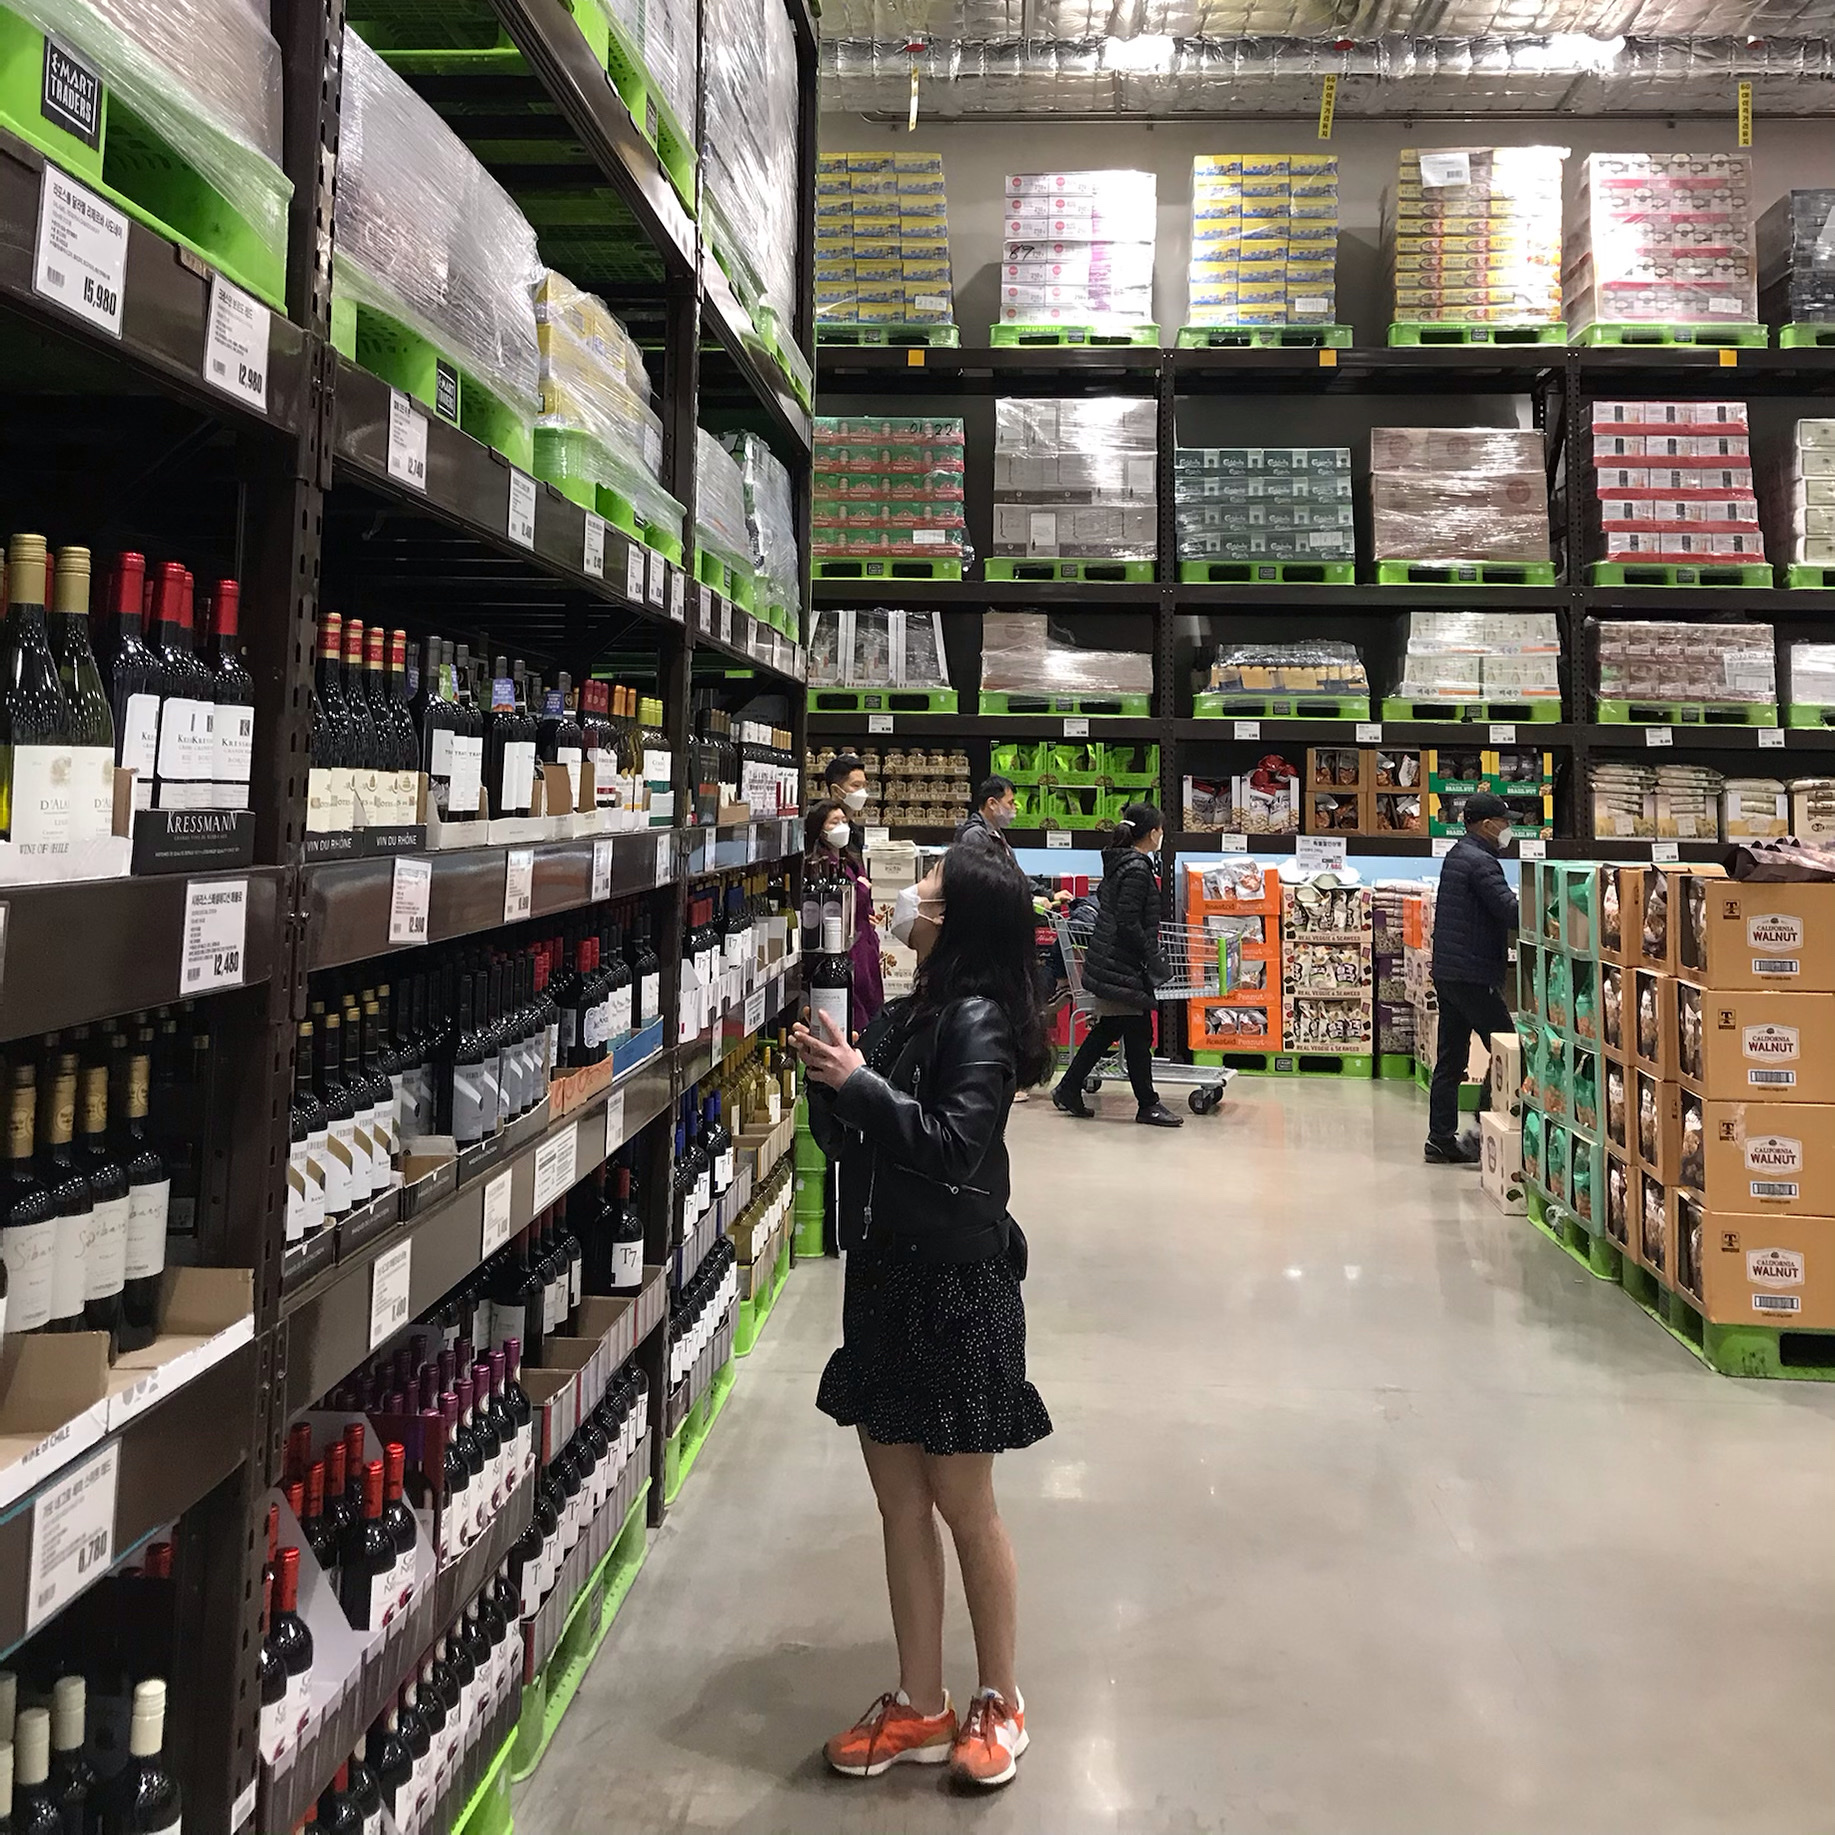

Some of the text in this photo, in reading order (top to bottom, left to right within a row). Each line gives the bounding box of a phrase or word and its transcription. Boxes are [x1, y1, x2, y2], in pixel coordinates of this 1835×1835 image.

[50, 74, 92, 122] TRADERS
[84, 276, 117, 316] 15,980
[238, 362, 263, 394] 12,980
[166, 811, 238, 834] KRESSMANN
[306, 841, 319, 852] VIN
[320, 840, 330, 850] DU
[376, 836, 387, 846] VIN
[388, 836, 396, 846] DU
[727, 936, 738, 950] T7
[1752, 932, 1798, 942] WALNUT
[214, 951, 240, 976] 12,480
[1238, 1038, 1265, 1046] Peanut
[1748, 1042, 1794, 1053] WALNUT
[1754, 1146, 1792, 1154] CALIFORNIA
[1750, 1154, 1797, 1166] WALNUT
[620, 1248, 638, 1268] T7
[1756, 1258, 1796, 1268] CALIFORNIA
[1752, 1266, 1800, 1278] WALNUT
[50, 1426, 70, 1448] CHILE
